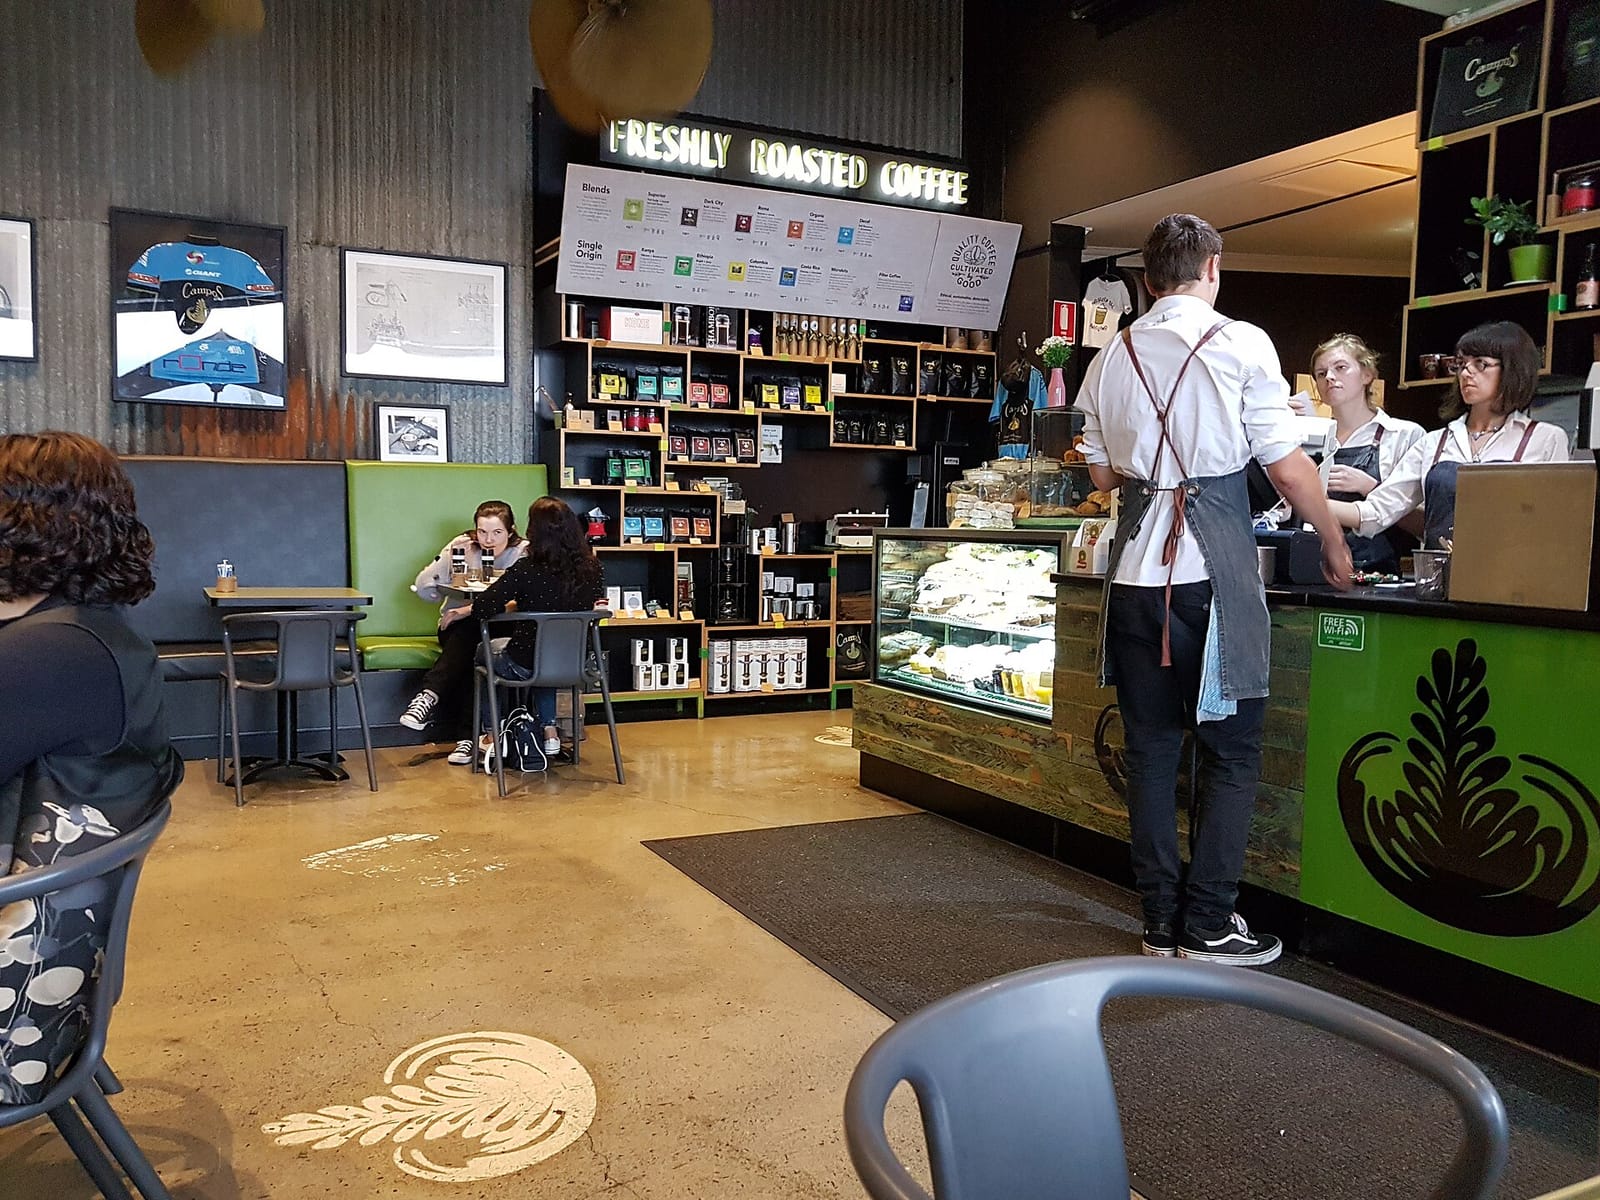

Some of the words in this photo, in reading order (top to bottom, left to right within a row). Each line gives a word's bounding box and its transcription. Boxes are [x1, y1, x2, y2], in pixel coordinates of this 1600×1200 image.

[609, 119, 732, 169] FRESHLY
[750, 138, 868, 189] ROASTED
[880, 161, 968, 205] COFFEE
[582, 183, 611, 194] Blends
[577, 240, 603, 251] Single
[951, 234, 980, 262] QUALITY
[981, 236, 997, 267] COFFEE
[576, 249, 602, 261] Origin
[192, 269, 222, 278] GIANT
[950, 263, 994, 275] CULTIVATED
[956, 277, 982, 289] GOOD
[1323, 616, 1345, 628] FREE
